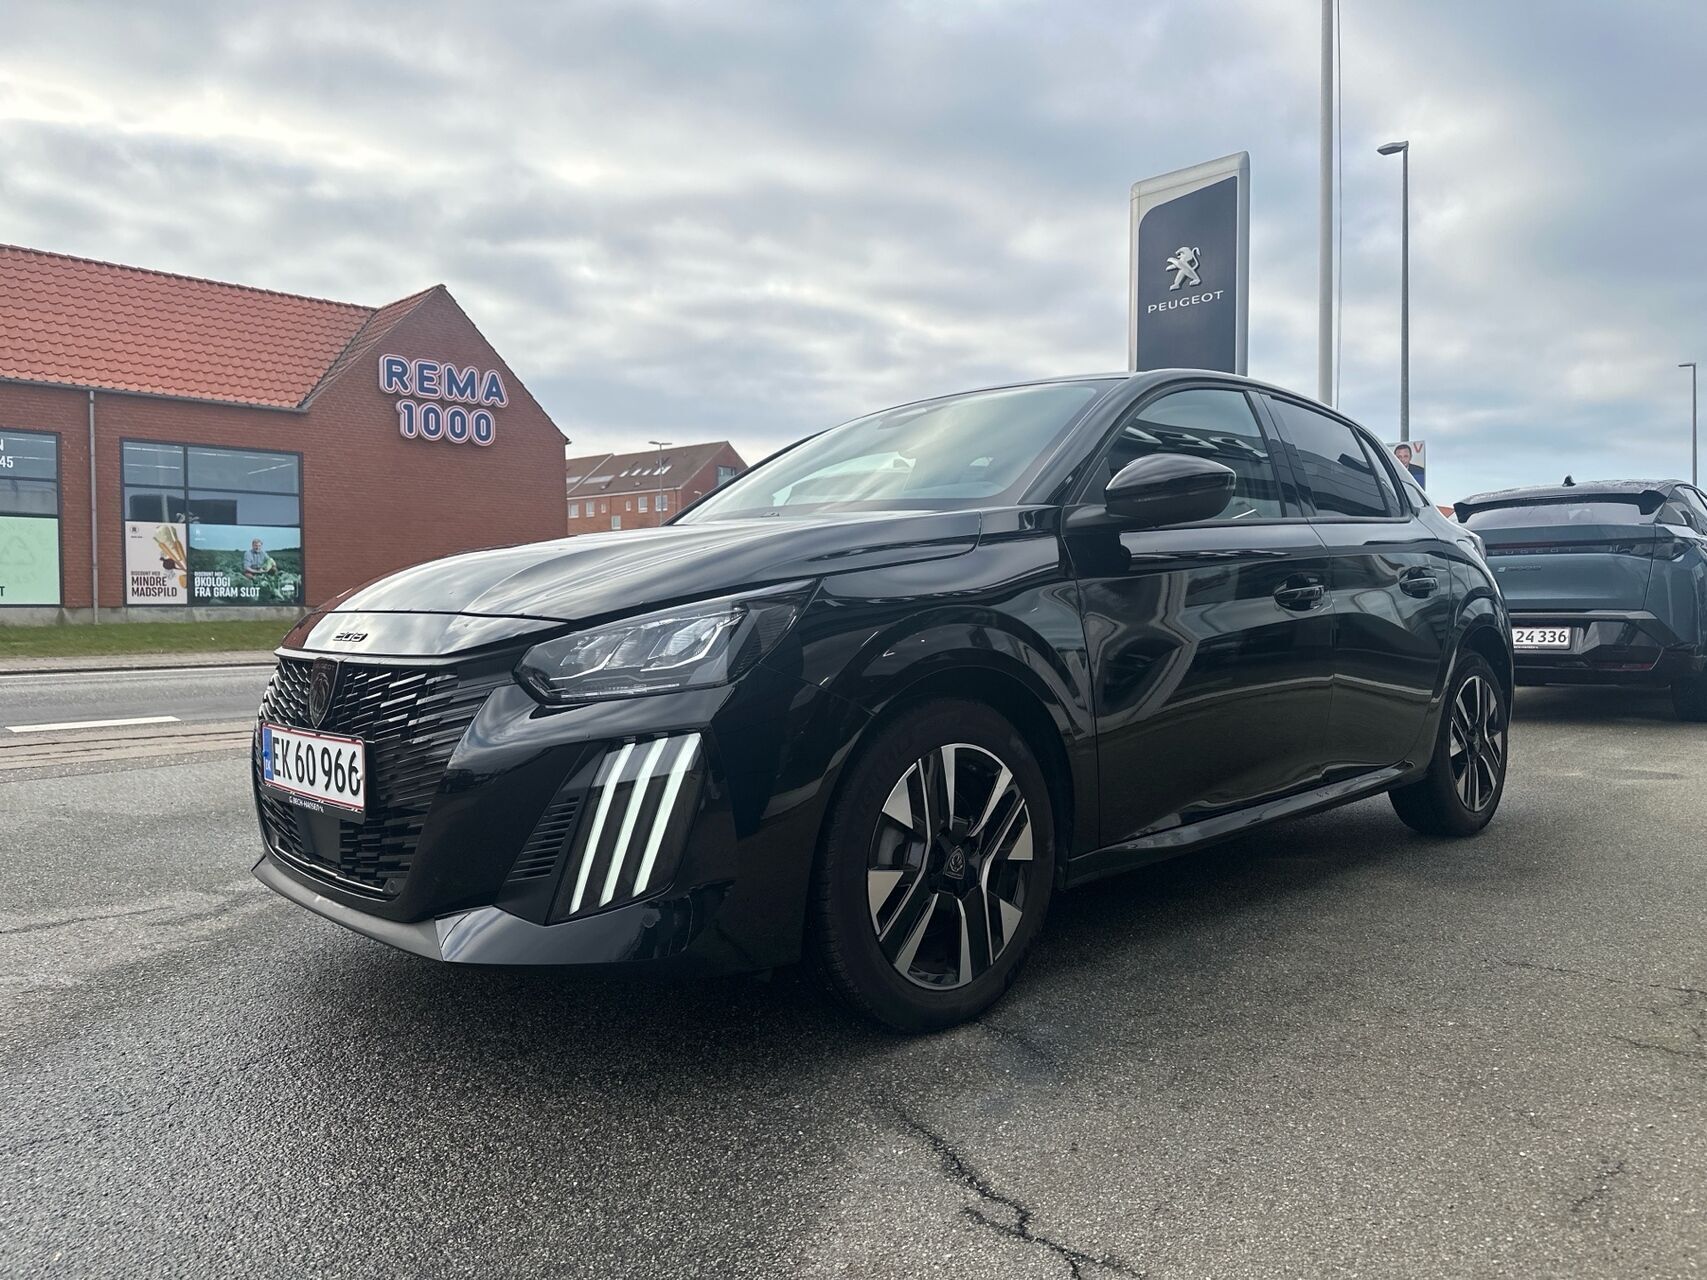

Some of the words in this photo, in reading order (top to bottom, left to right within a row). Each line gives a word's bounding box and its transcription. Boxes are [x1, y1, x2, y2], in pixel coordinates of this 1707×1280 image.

[1147, 290, 1224, 314] PEUGEOT
[379, 354, 509, 408] REMA
[395, 399, 496, 447] 1000
[1413, 442, 1424, 453] V
[131, 576, 167, 586] MINDRE
[194, 576, 231, 587] ØKOLOGI
[131, 586, 178, 597] MADSPILD
[194, 587, 211, 597] FRA
[213, 587, 238, 597] GRAM
[240, 587, 261, 597] SLOT
[1515, 630, 1535, 643] 24
[1537, 630, 1567, 643] 336
[272, 735, 293, 781] EK
[295, 740, 316, 787] 60
[320, 746, 362, 797] 966
